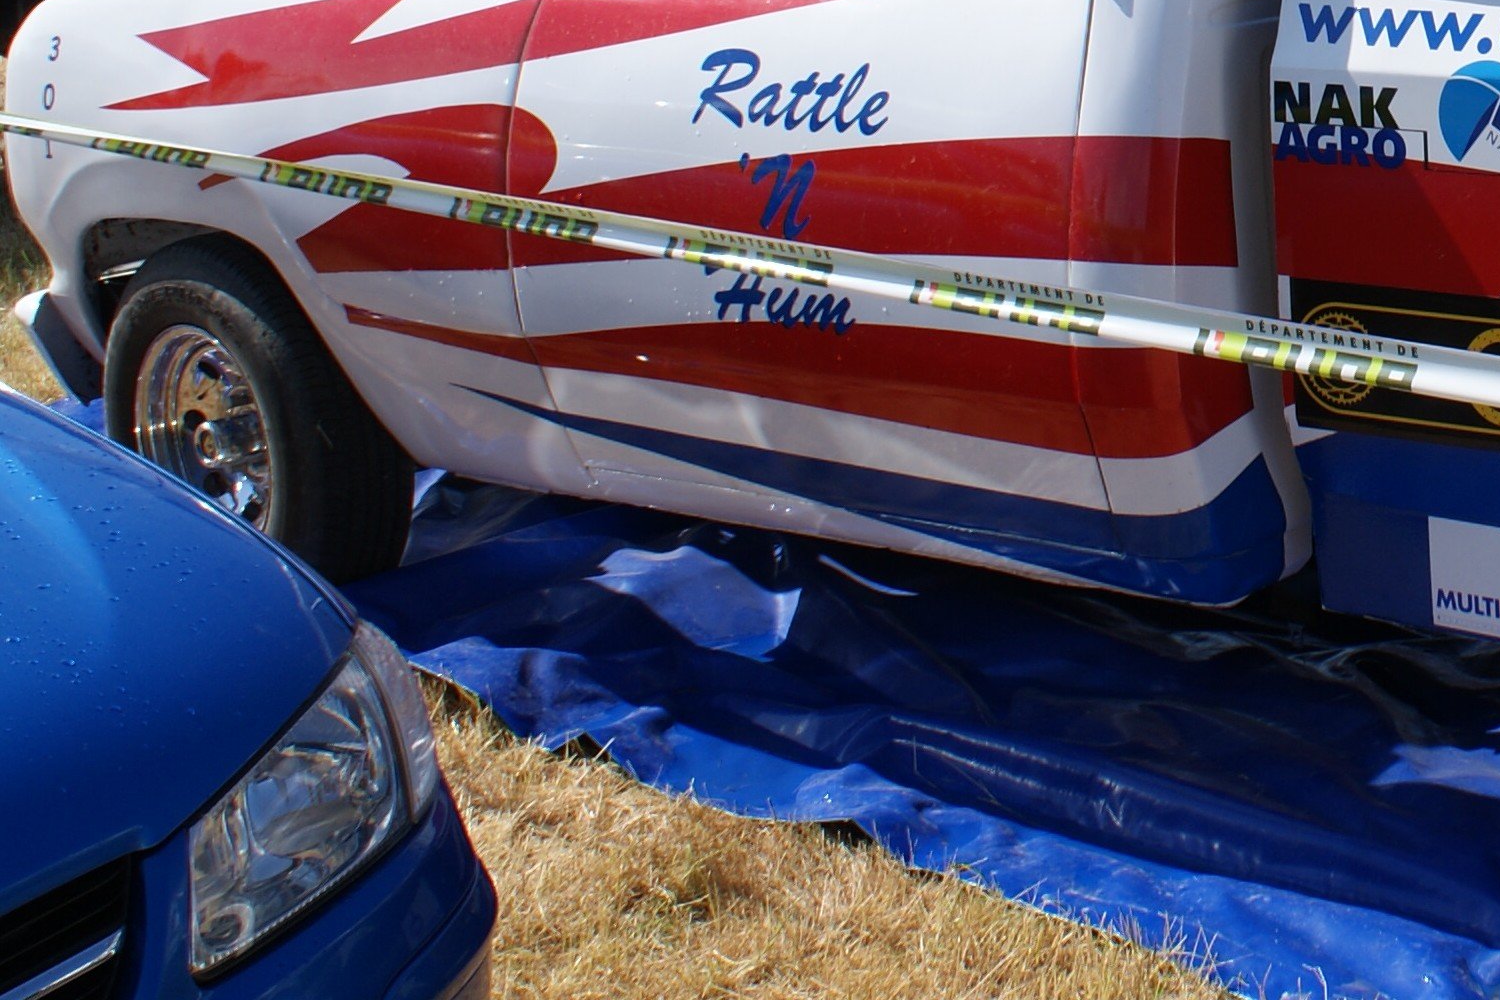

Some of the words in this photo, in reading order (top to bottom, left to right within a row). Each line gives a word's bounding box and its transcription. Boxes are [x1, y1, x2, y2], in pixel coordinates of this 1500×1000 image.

[691, 48, 890, 136] Rattle
[1274, 81, 1398, 130] NAK
[1274, 122, 1407, 170] AGRO
[705, 262, 857, 336] Hum
[953, 271, 1075, 302] DÉPARTEMENT
[1084, 293, 1105, 307] DE
[1246, 319, 1384, 352] DÉPARTEMENT
[1397, 344, 1420, 359] DE
